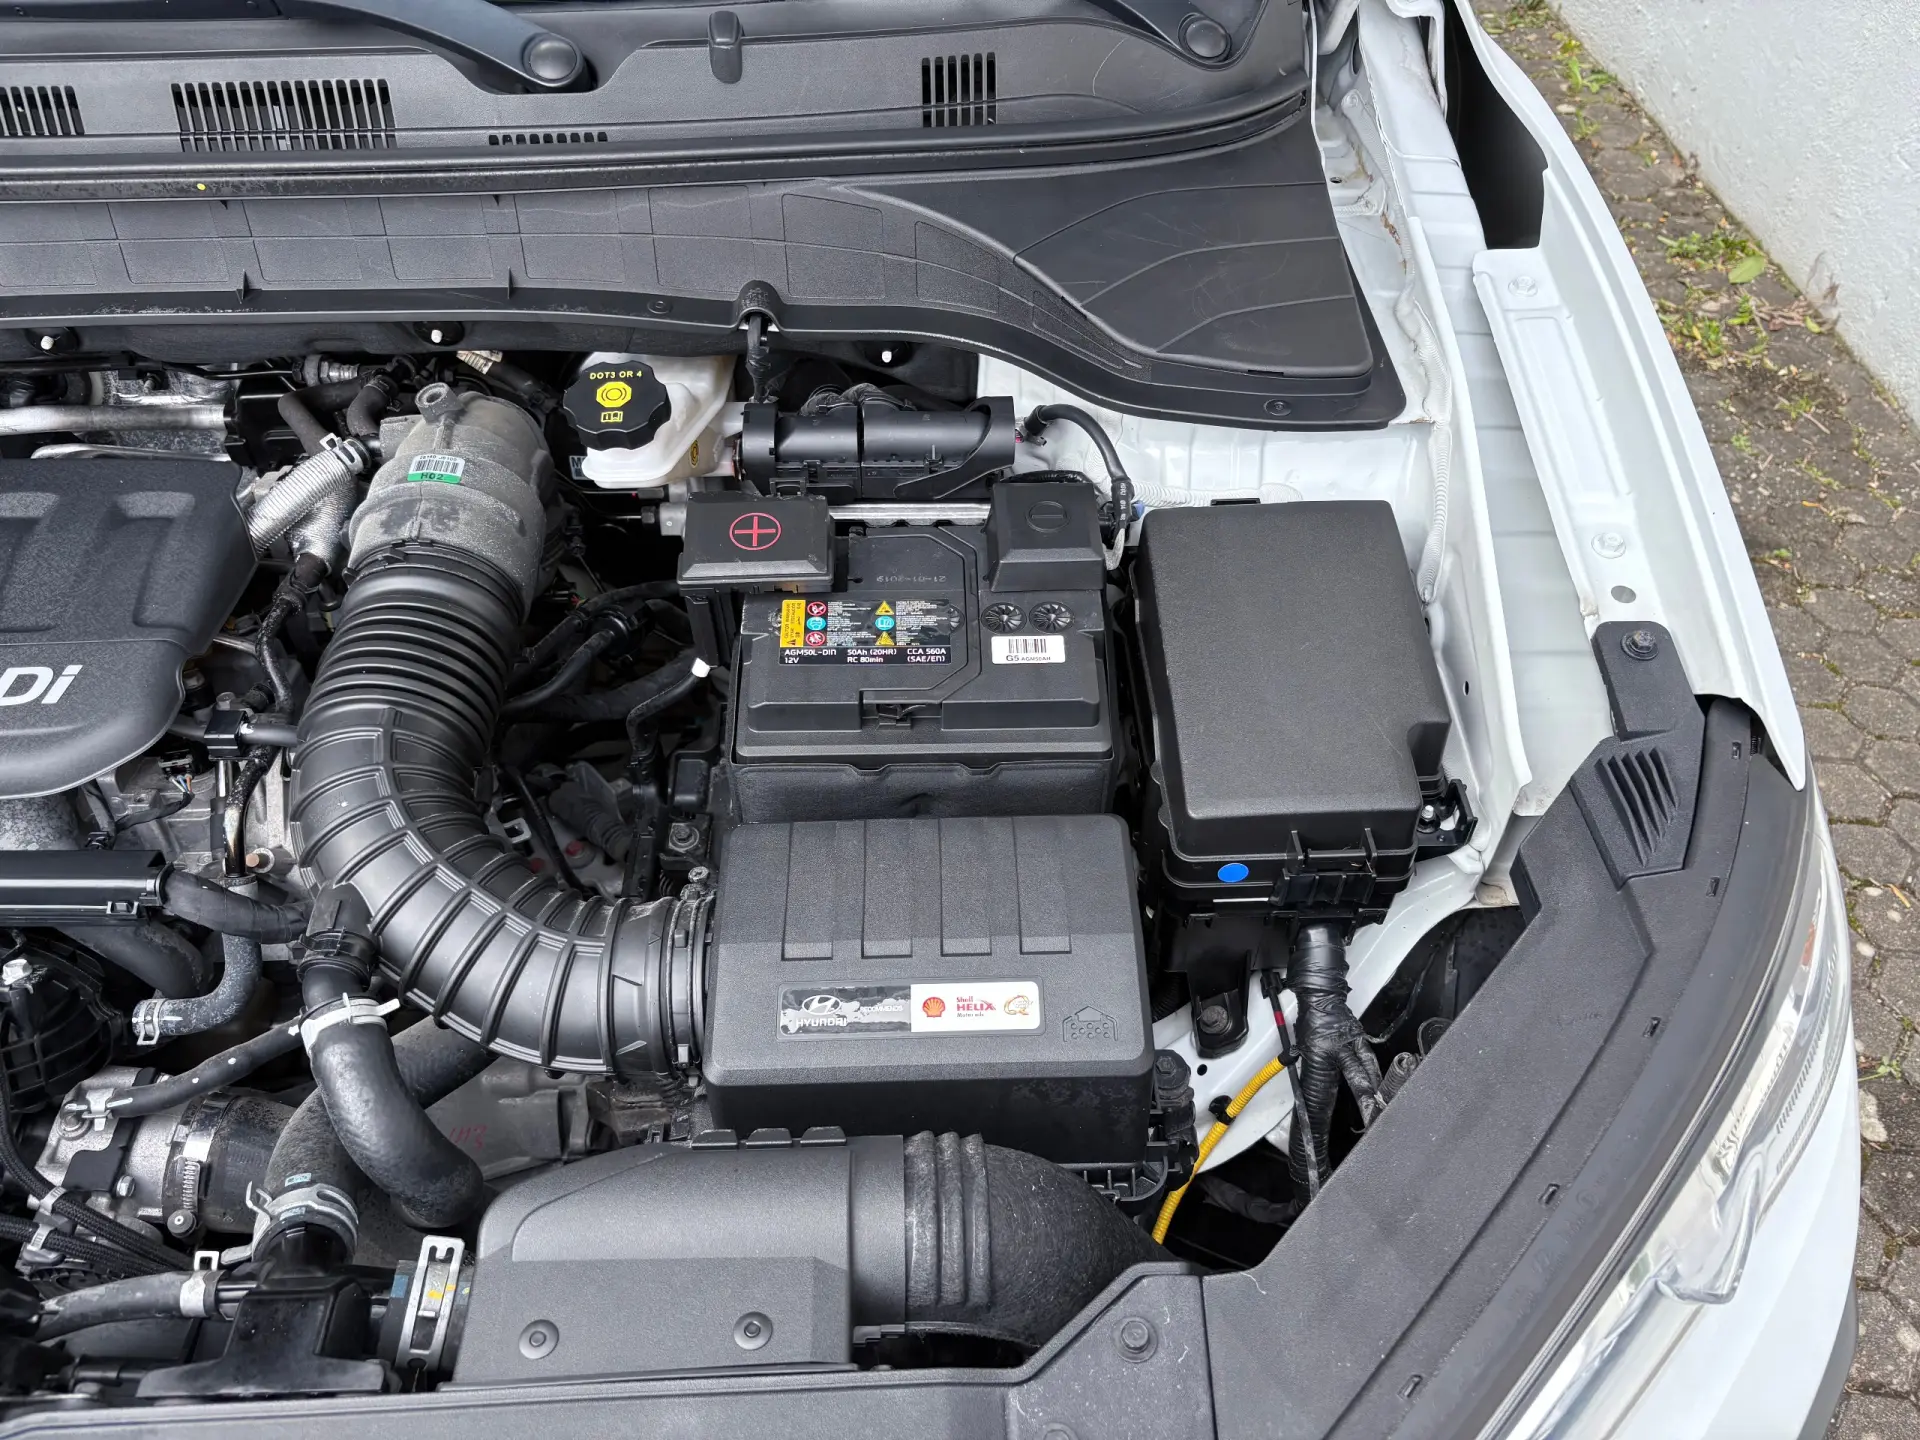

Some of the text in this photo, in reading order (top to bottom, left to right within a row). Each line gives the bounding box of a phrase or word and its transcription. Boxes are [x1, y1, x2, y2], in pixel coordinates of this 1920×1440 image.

[589, 371, 616, 380] DOT3
[619, 370, 634, 378] OR
[847, 648, 897, 656] 50Ah (20HR)
[784, 656, 800, 664] 12V
[956, 995, 974, 1003] Shell
[956, 1002, 997, 1012] HELIX
[795, 1017, 848, 1027] HYUNDAI
